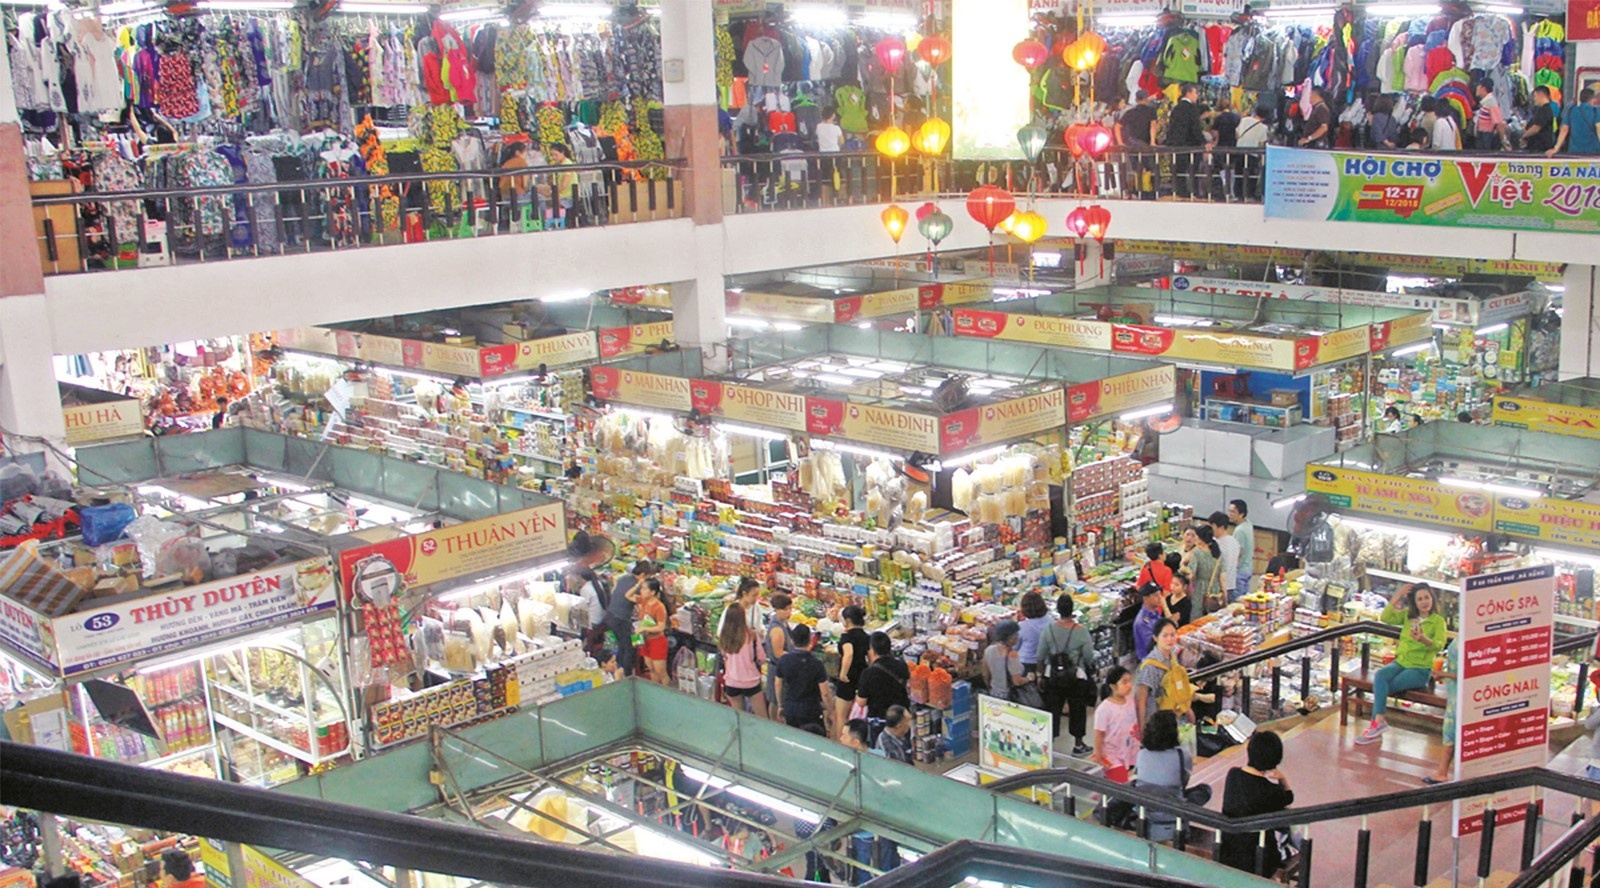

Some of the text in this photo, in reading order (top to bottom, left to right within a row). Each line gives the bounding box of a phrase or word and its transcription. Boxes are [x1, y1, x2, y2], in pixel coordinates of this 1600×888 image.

[1345, 155, 1441, 182] HỘI CHỢ
[1384, 187, 1419, 198] 12-17
[1455, 162, 1533, 207] Việt
[1384, 199, 1418, 208] 12/2018
[737, 390, 804, 413] SHOP NHI
[996, 401, 1027, 421] NAM
[865, 410, 895, 427] NAM
[1545, 415, 1597, 430] NA
[519, 510, 557, 536] YẾN
[130, 575, 281, 624] THÙY DUYÊN
[1476, 595, 1540, 617] CÔNG SPA
[92, 616, 112, 629] 53
[1473, 678, 1540, 702] CÔNG NAIL
